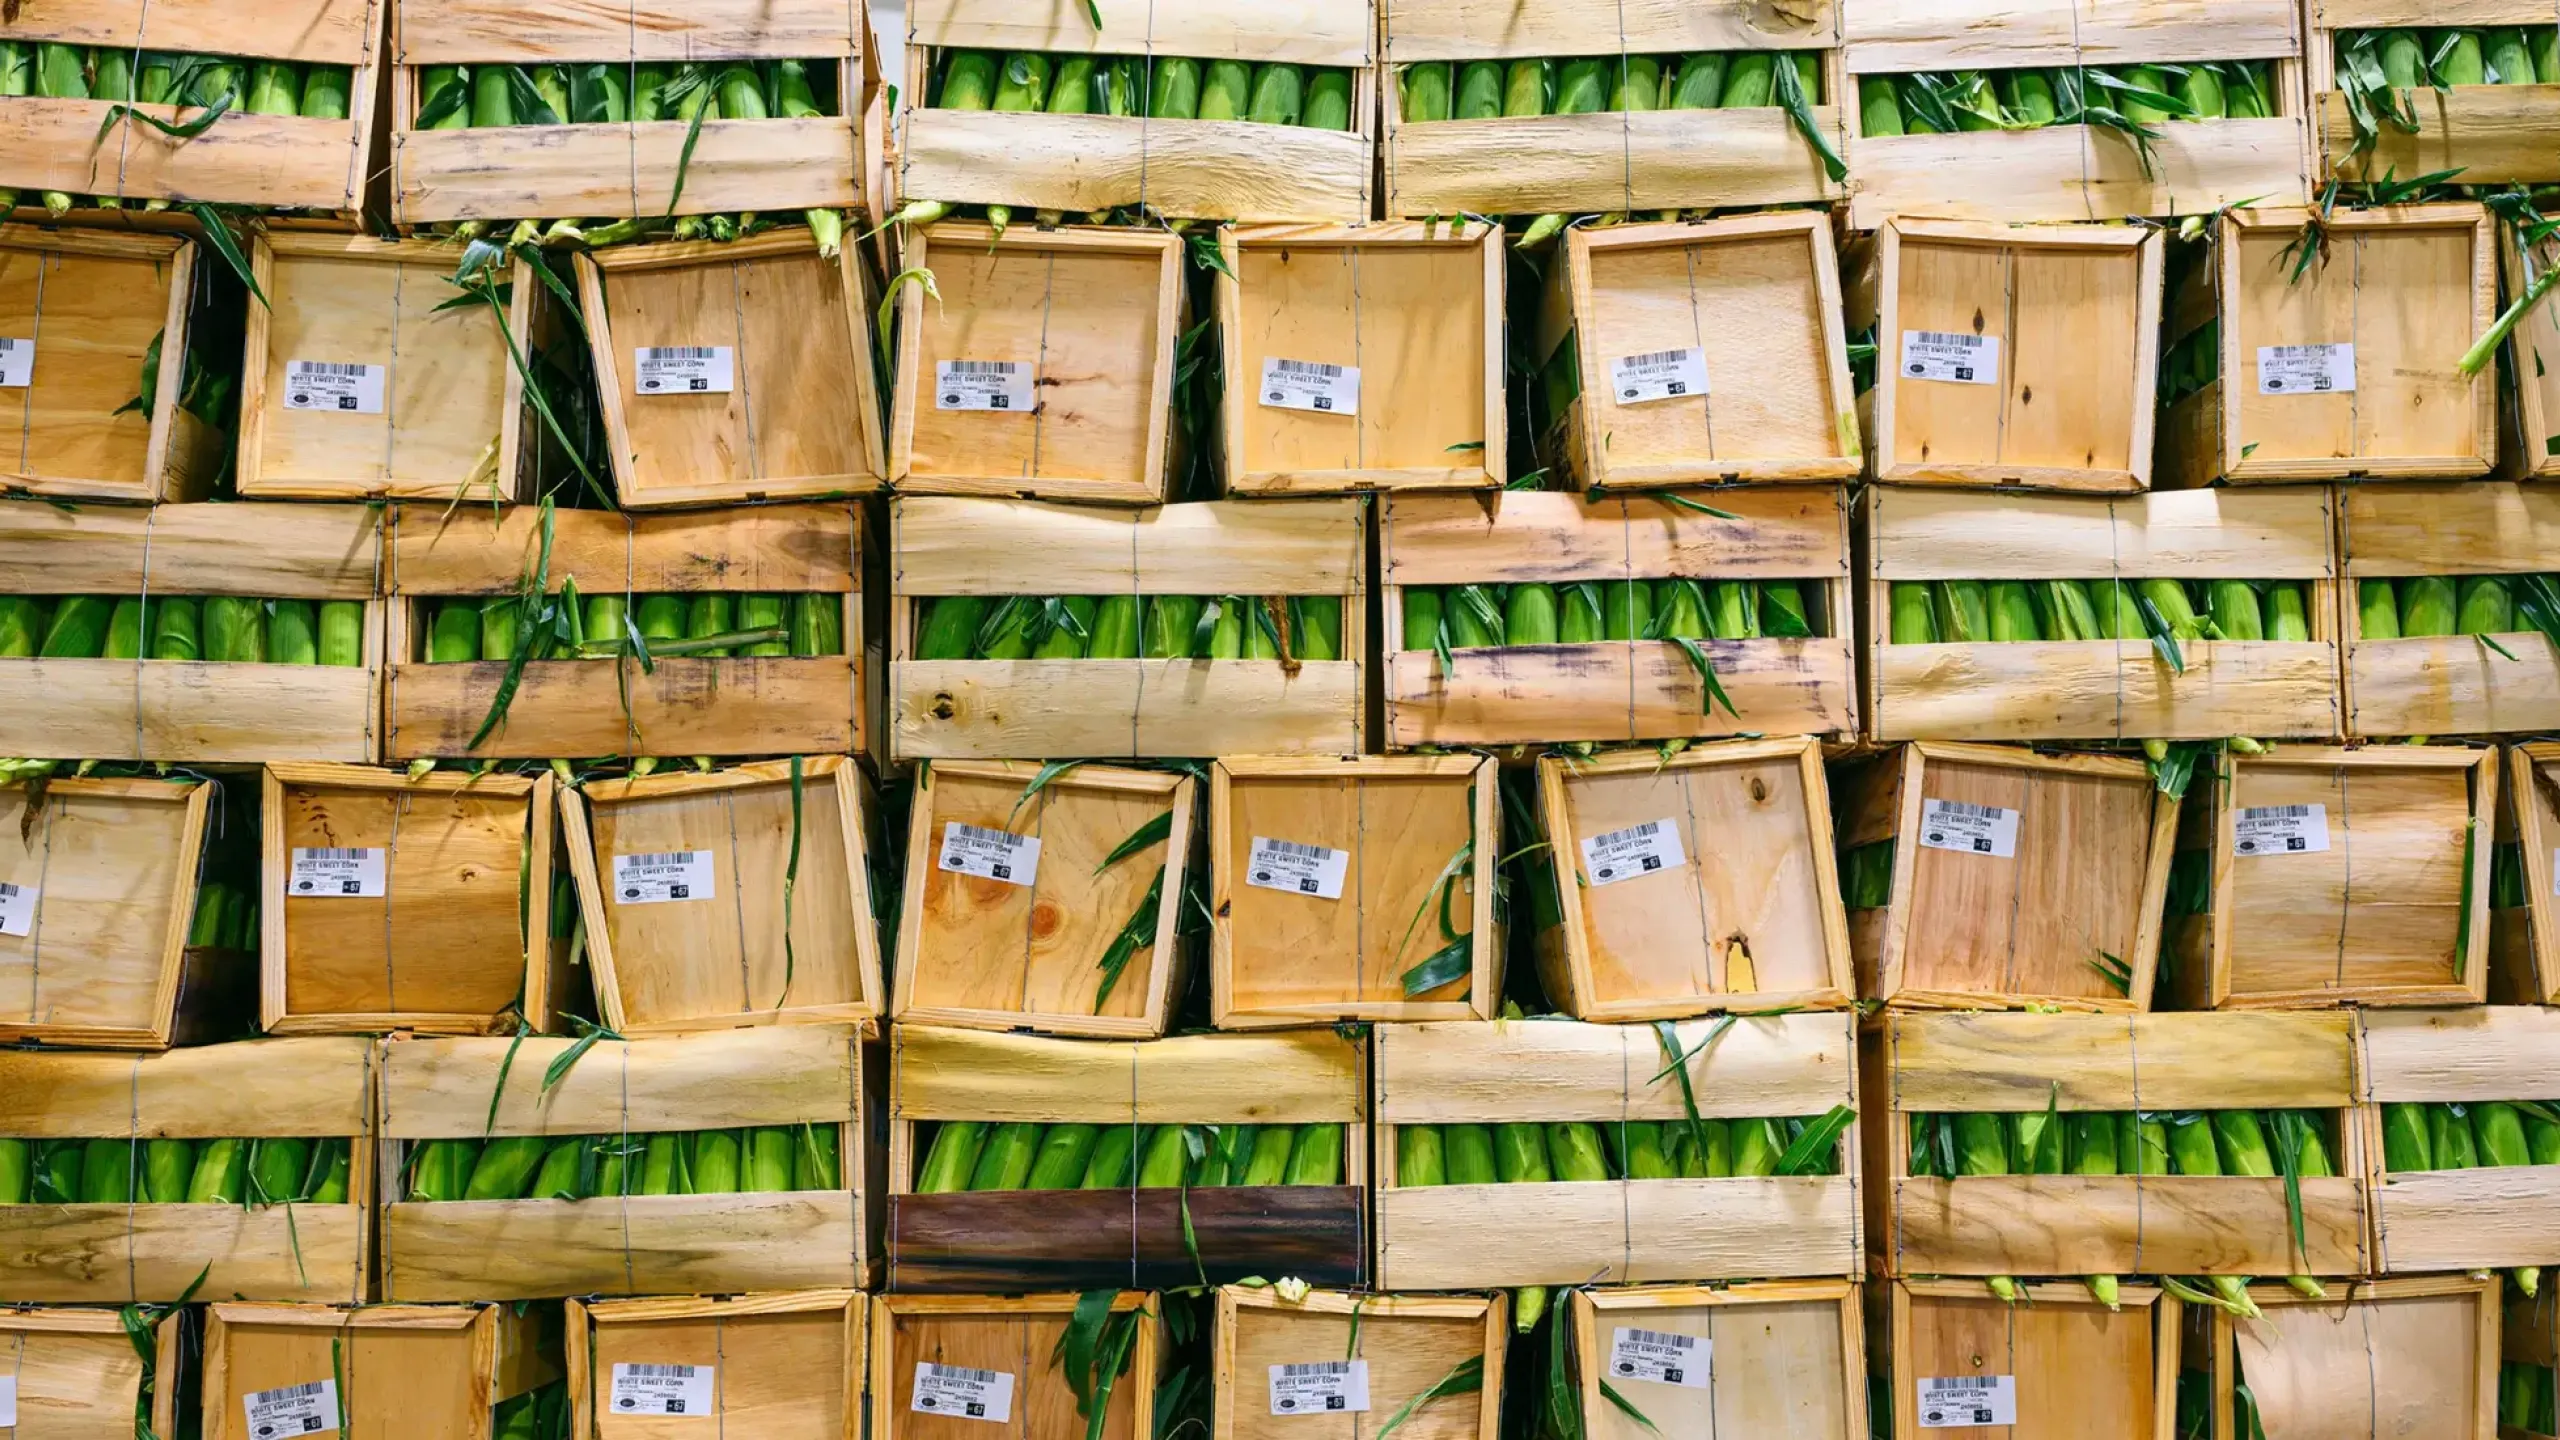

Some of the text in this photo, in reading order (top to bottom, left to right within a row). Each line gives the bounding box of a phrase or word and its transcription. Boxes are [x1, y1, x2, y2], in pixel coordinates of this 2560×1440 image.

[1954, 348, 1972, 356] CORN
[1951, 816, 1972, 825] SWEET
[1974, 819, 1992, 828] CORN
[971, 841, 993, 851] SWEET
[994, 845, 1012, 854] CORN
[1611, 843, 1633, 854] SWEET
[1634, 838, 1653, 848] CORN
[1278, 855, 1300, 865] SWEET
[1301, 859, 1320, 868] CORN
[1641, 1345, 1663, 1354] SWEET
[1665, 1348, 1683, 1357] CORN
[943, 1380, 965, 1389] SWEET
[966, 1383, 985, 1391] CORN
[273, 1402, 296, 1411] SWEET
[297, 1398, 316, 1407] CORN
